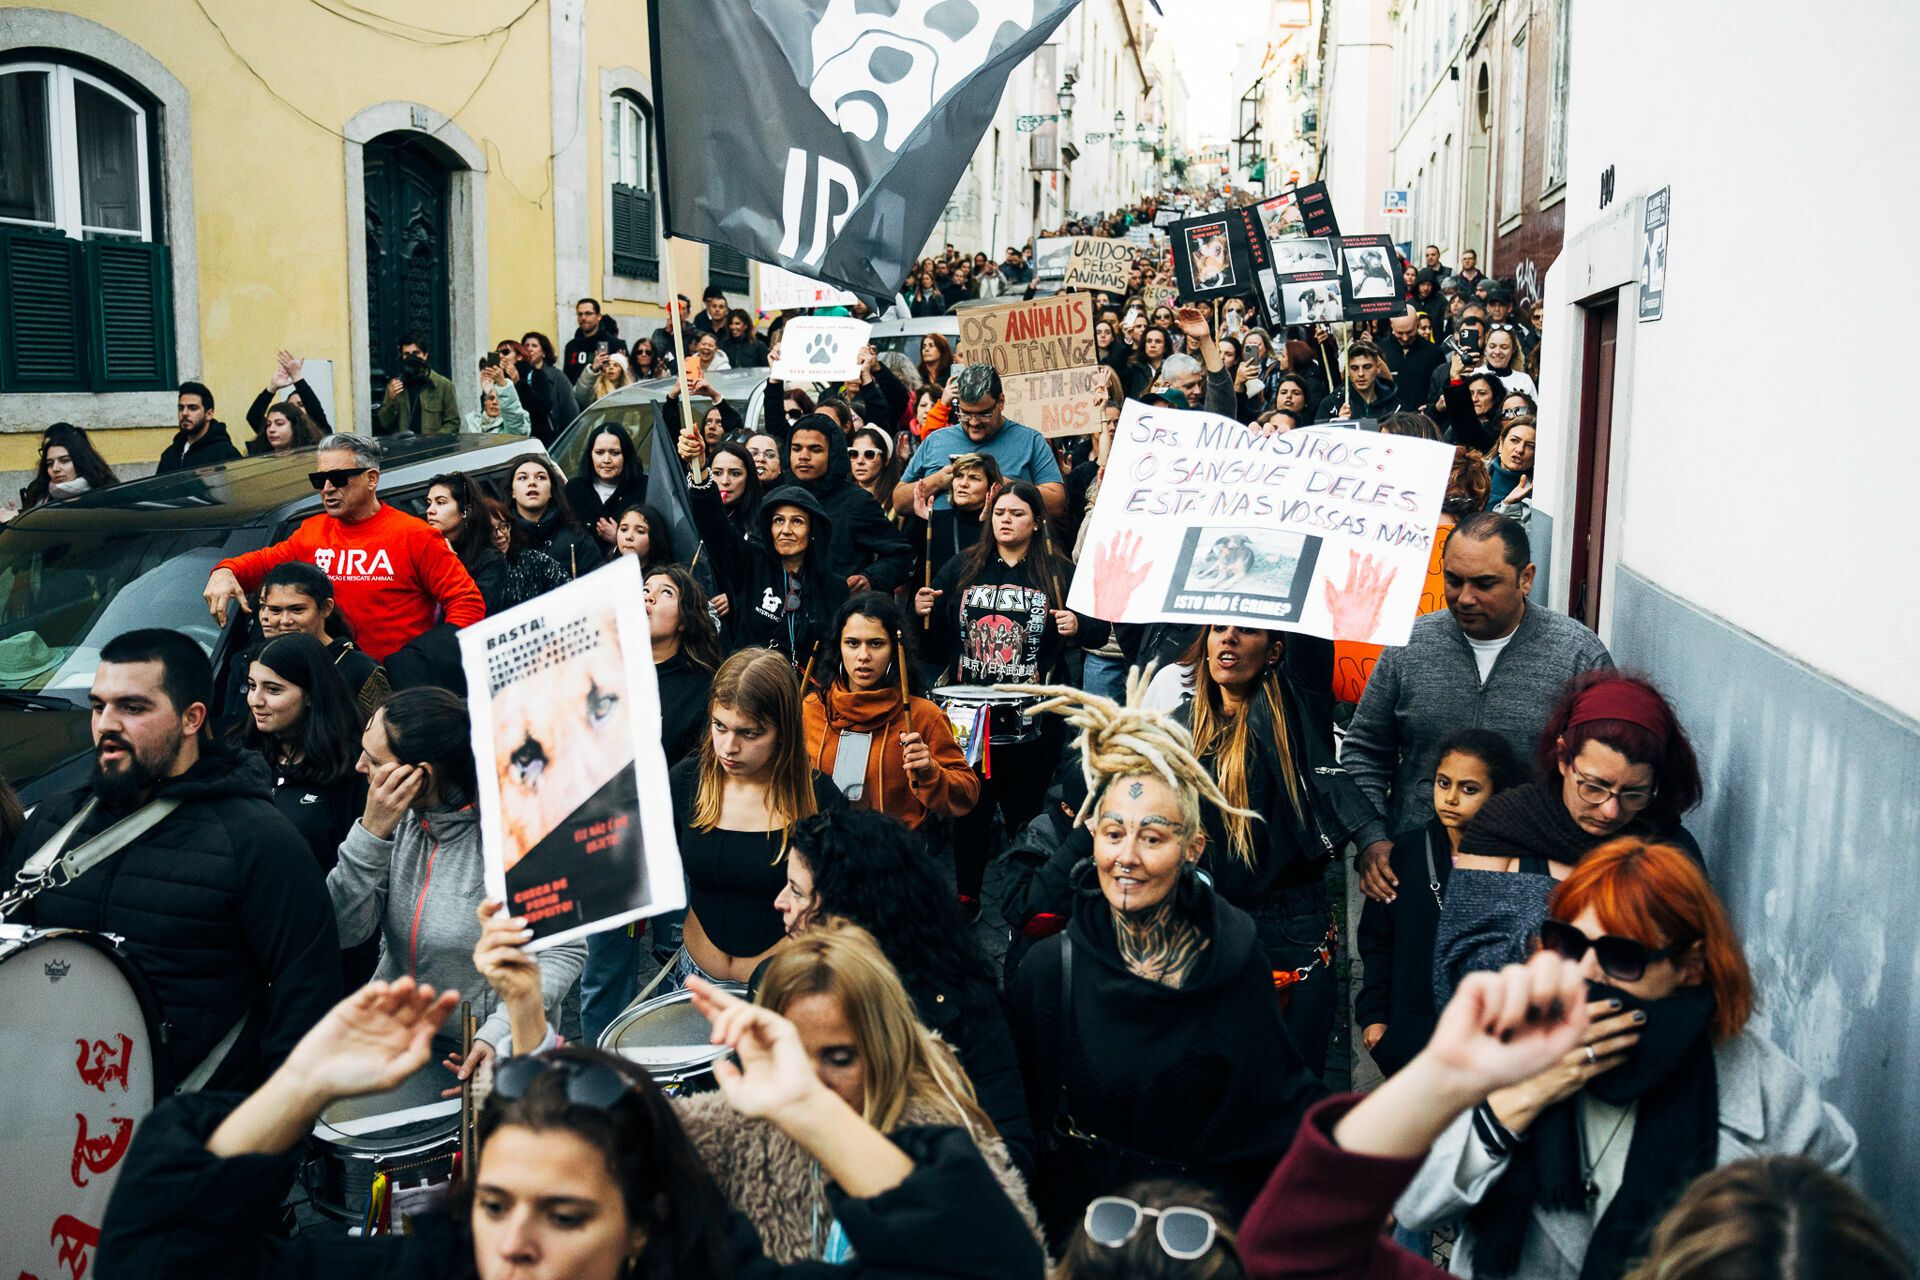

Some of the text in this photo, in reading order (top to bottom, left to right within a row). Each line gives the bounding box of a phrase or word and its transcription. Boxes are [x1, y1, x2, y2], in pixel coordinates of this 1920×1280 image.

[1074, 240, 1136, 261] UNIDOS
[1083, 258, 1122, 273] PELOS
[1066, 267, 1125, 290] ANIMAIS
[963, 312, 998, 347] OS
[1012, 340, 1058, 374] TÊM
[1041, 397, 1090, 433] NÓS
[1130, 452, 1421, 513] O SANGUE DELES
[1208, 490, 1274, 517] NAS
[1279, 498, 1366, 536] VOSSAS
[337, 549, 394, 575] IRA
[969, 585, 1031, 612] KISS
[1173, 595, 1204, 609] ISTO
[1203, 594, 1231, 611] NÃO
[1229, 595, 1241, 612] É
[486, 616, 546, 650] BASTA!
